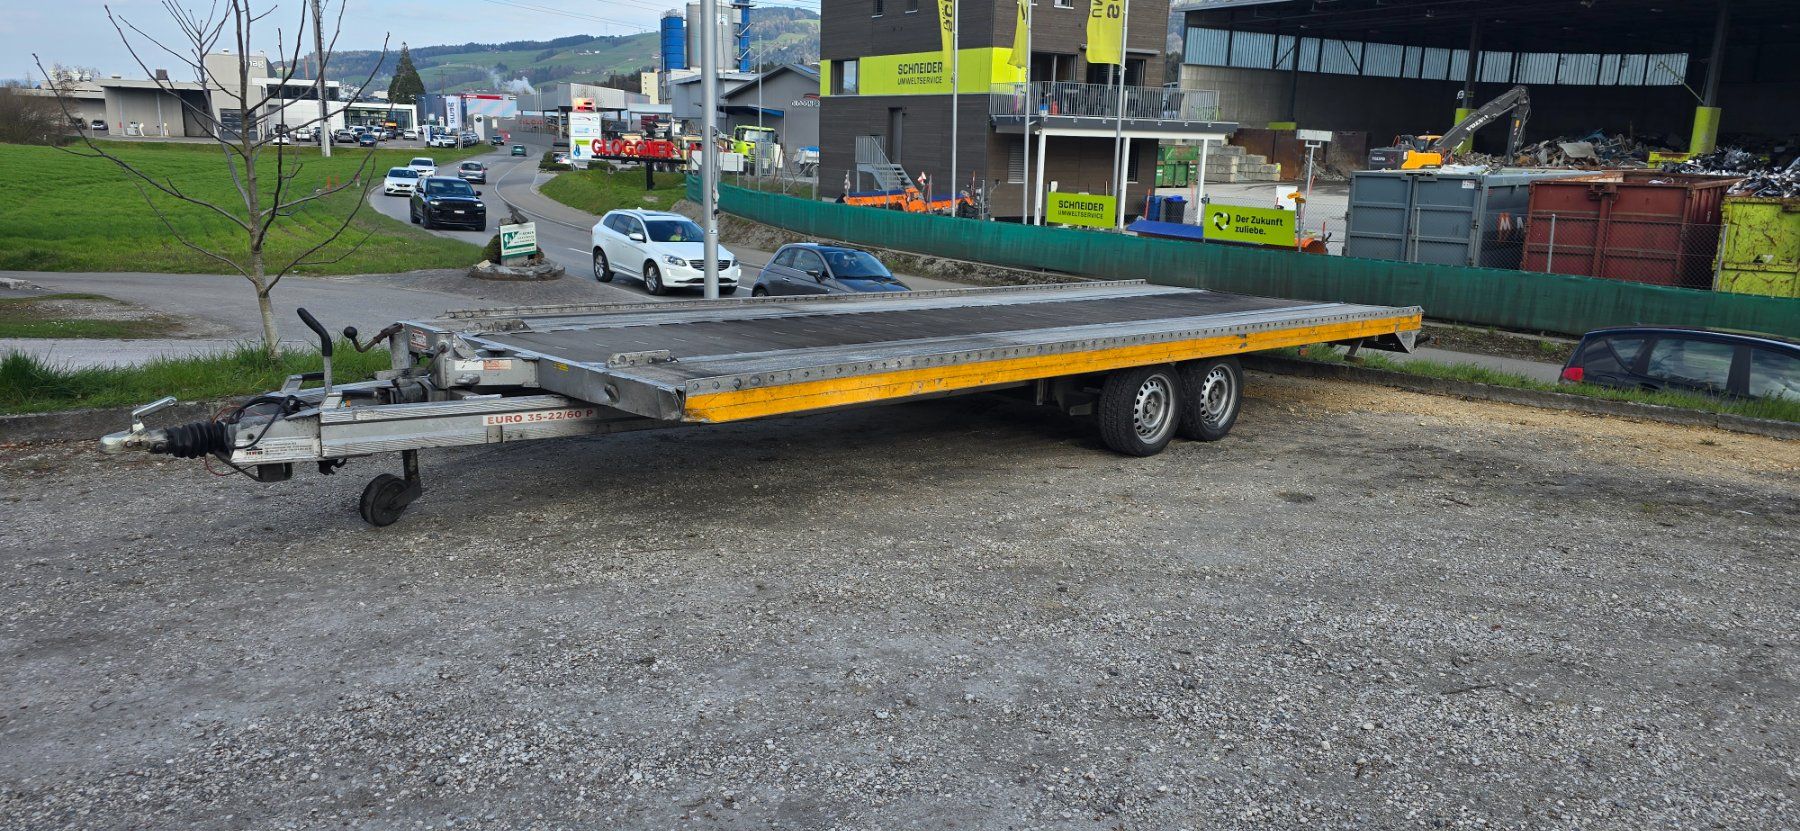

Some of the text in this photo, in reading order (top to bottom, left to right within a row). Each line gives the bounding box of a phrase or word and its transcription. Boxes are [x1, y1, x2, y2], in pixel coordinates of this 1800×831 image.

[897, 61, 943, 75] SCHNEIDER
[897, 76, 943, 85] UMWELTSERVICE
[1058, 200, 1104, 212] SCHNEIDER
[1057, 210, 1103, 219] UMWELTSERVICE
[1235, 214, 1283, 226] Der Zukunft
[1235, 225, 1267, 235] zuliebe.
[487, 409, 593, 425] EURO 35-22/60 P
